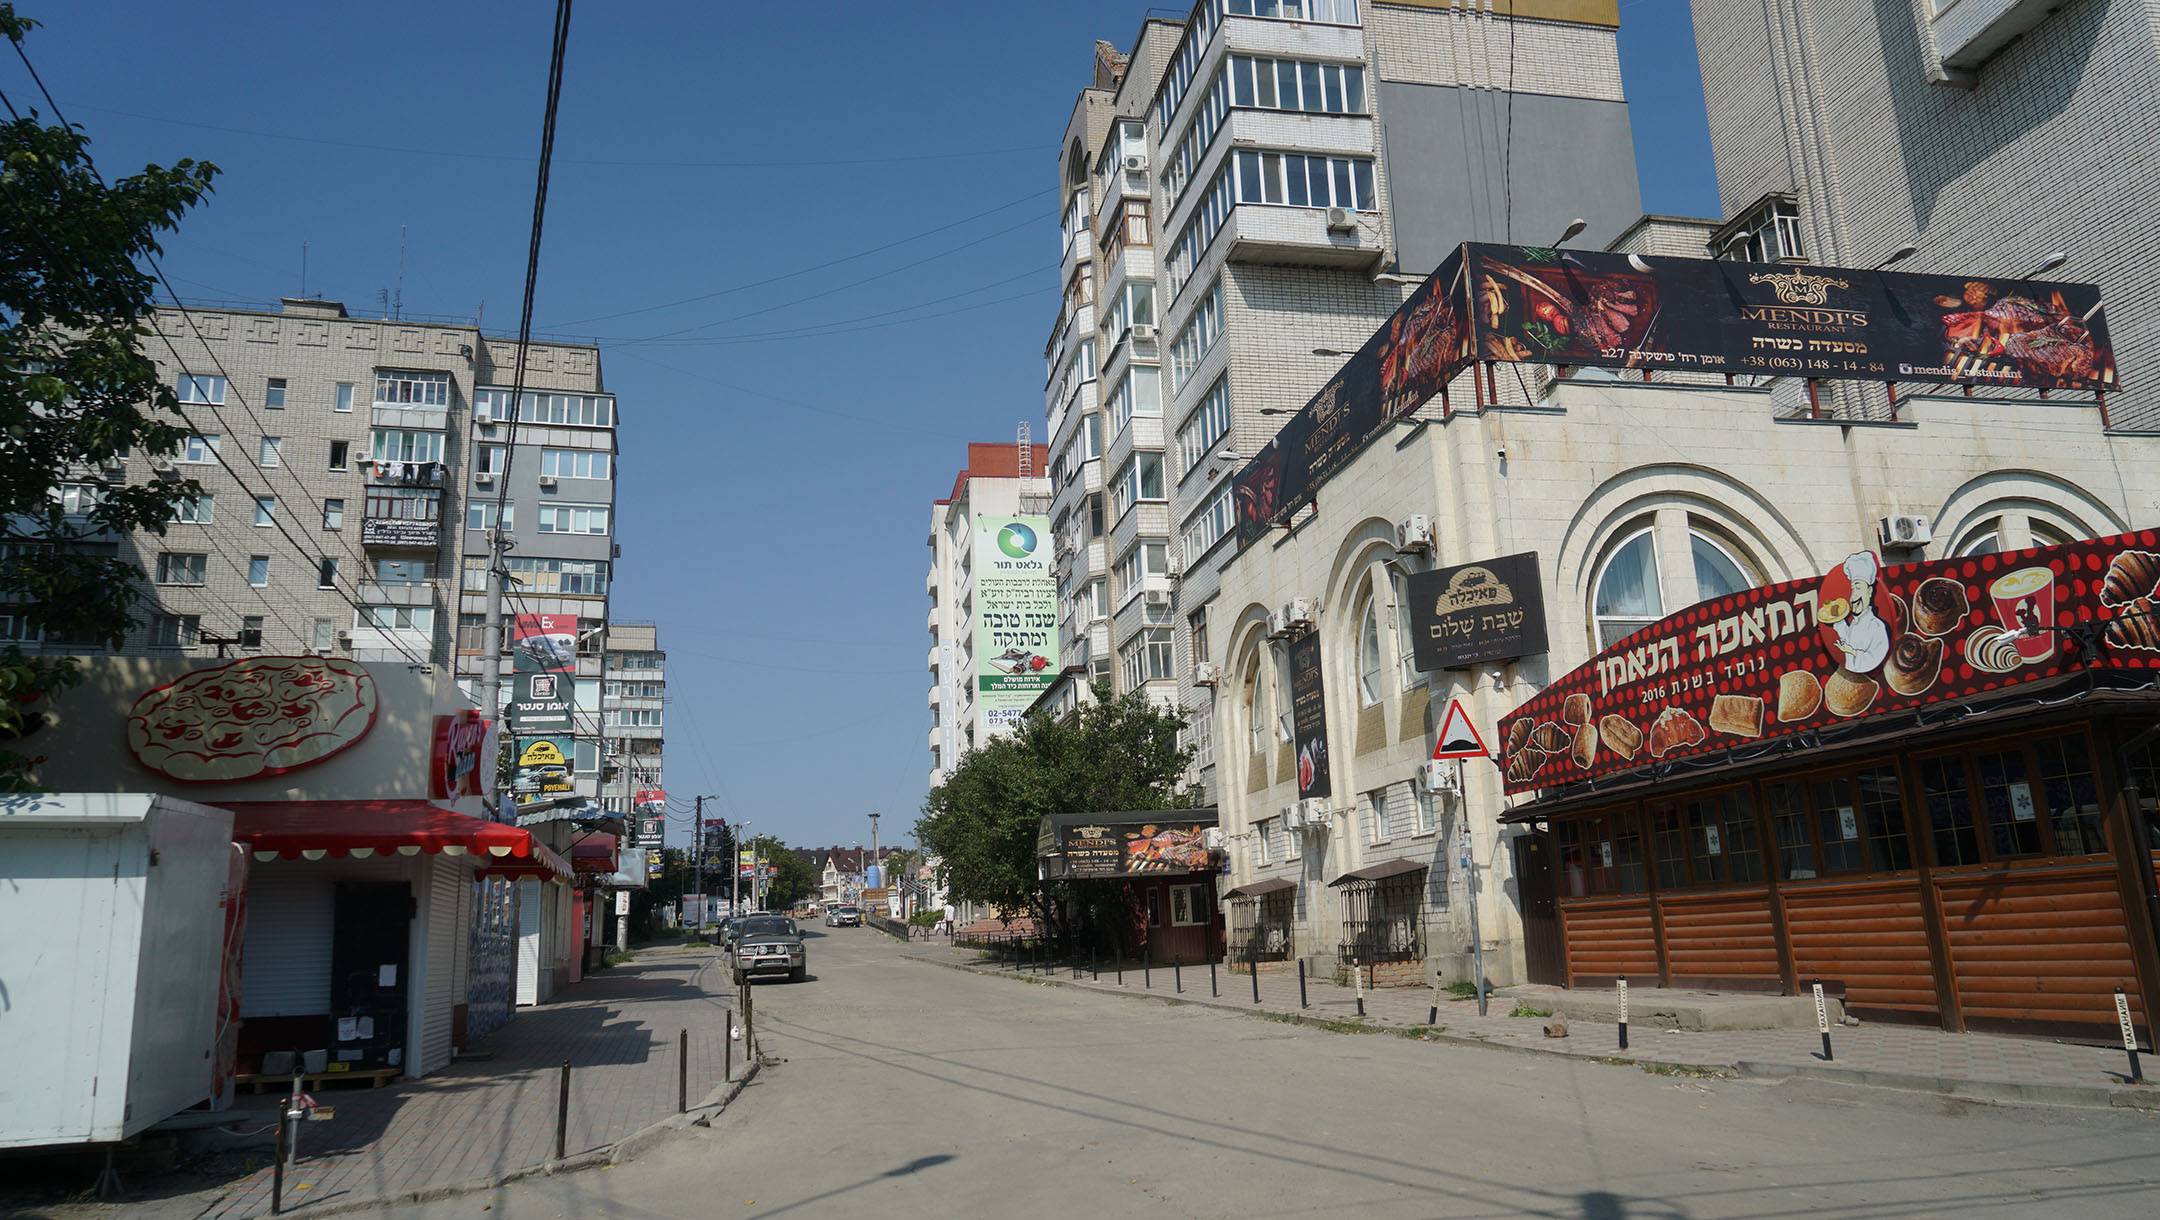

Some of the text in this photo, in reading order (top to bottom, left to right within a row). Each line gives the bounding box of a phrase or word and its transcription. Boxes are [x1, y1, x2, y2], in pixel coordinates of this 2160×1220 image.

[1741, 307, 1868, 327] MENDI'S
[1768, 322, 1847, 333] RESTAURANT
[1752, 336, 1868, 354] מסעדה כשרה
[1629, 350, 1674, 362] פושקינה
[1700, 355, 1725, 365] אומן
[1740, 355, 1765, 367] +38
[1768, 356, 1803, 370] (063)
[1807, 359, 1830, 369] 148
[1843, 361, 1857, 371] 14
[1869, 362, 1885, 372] 84
[1914, 366, 2023, 379] mendis_rstaurant
[993, 560, 1043, 569] גלאט תור
[1036, 589, 1057, 598] לציון
[986, 600, 1052, 609] ולכל בית ישראל
[983, 613, 1056, 628] שנה טובה
[993, 632, 1048, 648] ומתוקה
[1596, 589, 1818, 698] המאפה הנאמן
[1642, 656, 1766, 704] נוסד בשנת 2016
[516, 702, 569, 711] אומן סנטר
[528, 752, 555, 760] פאיכלה
